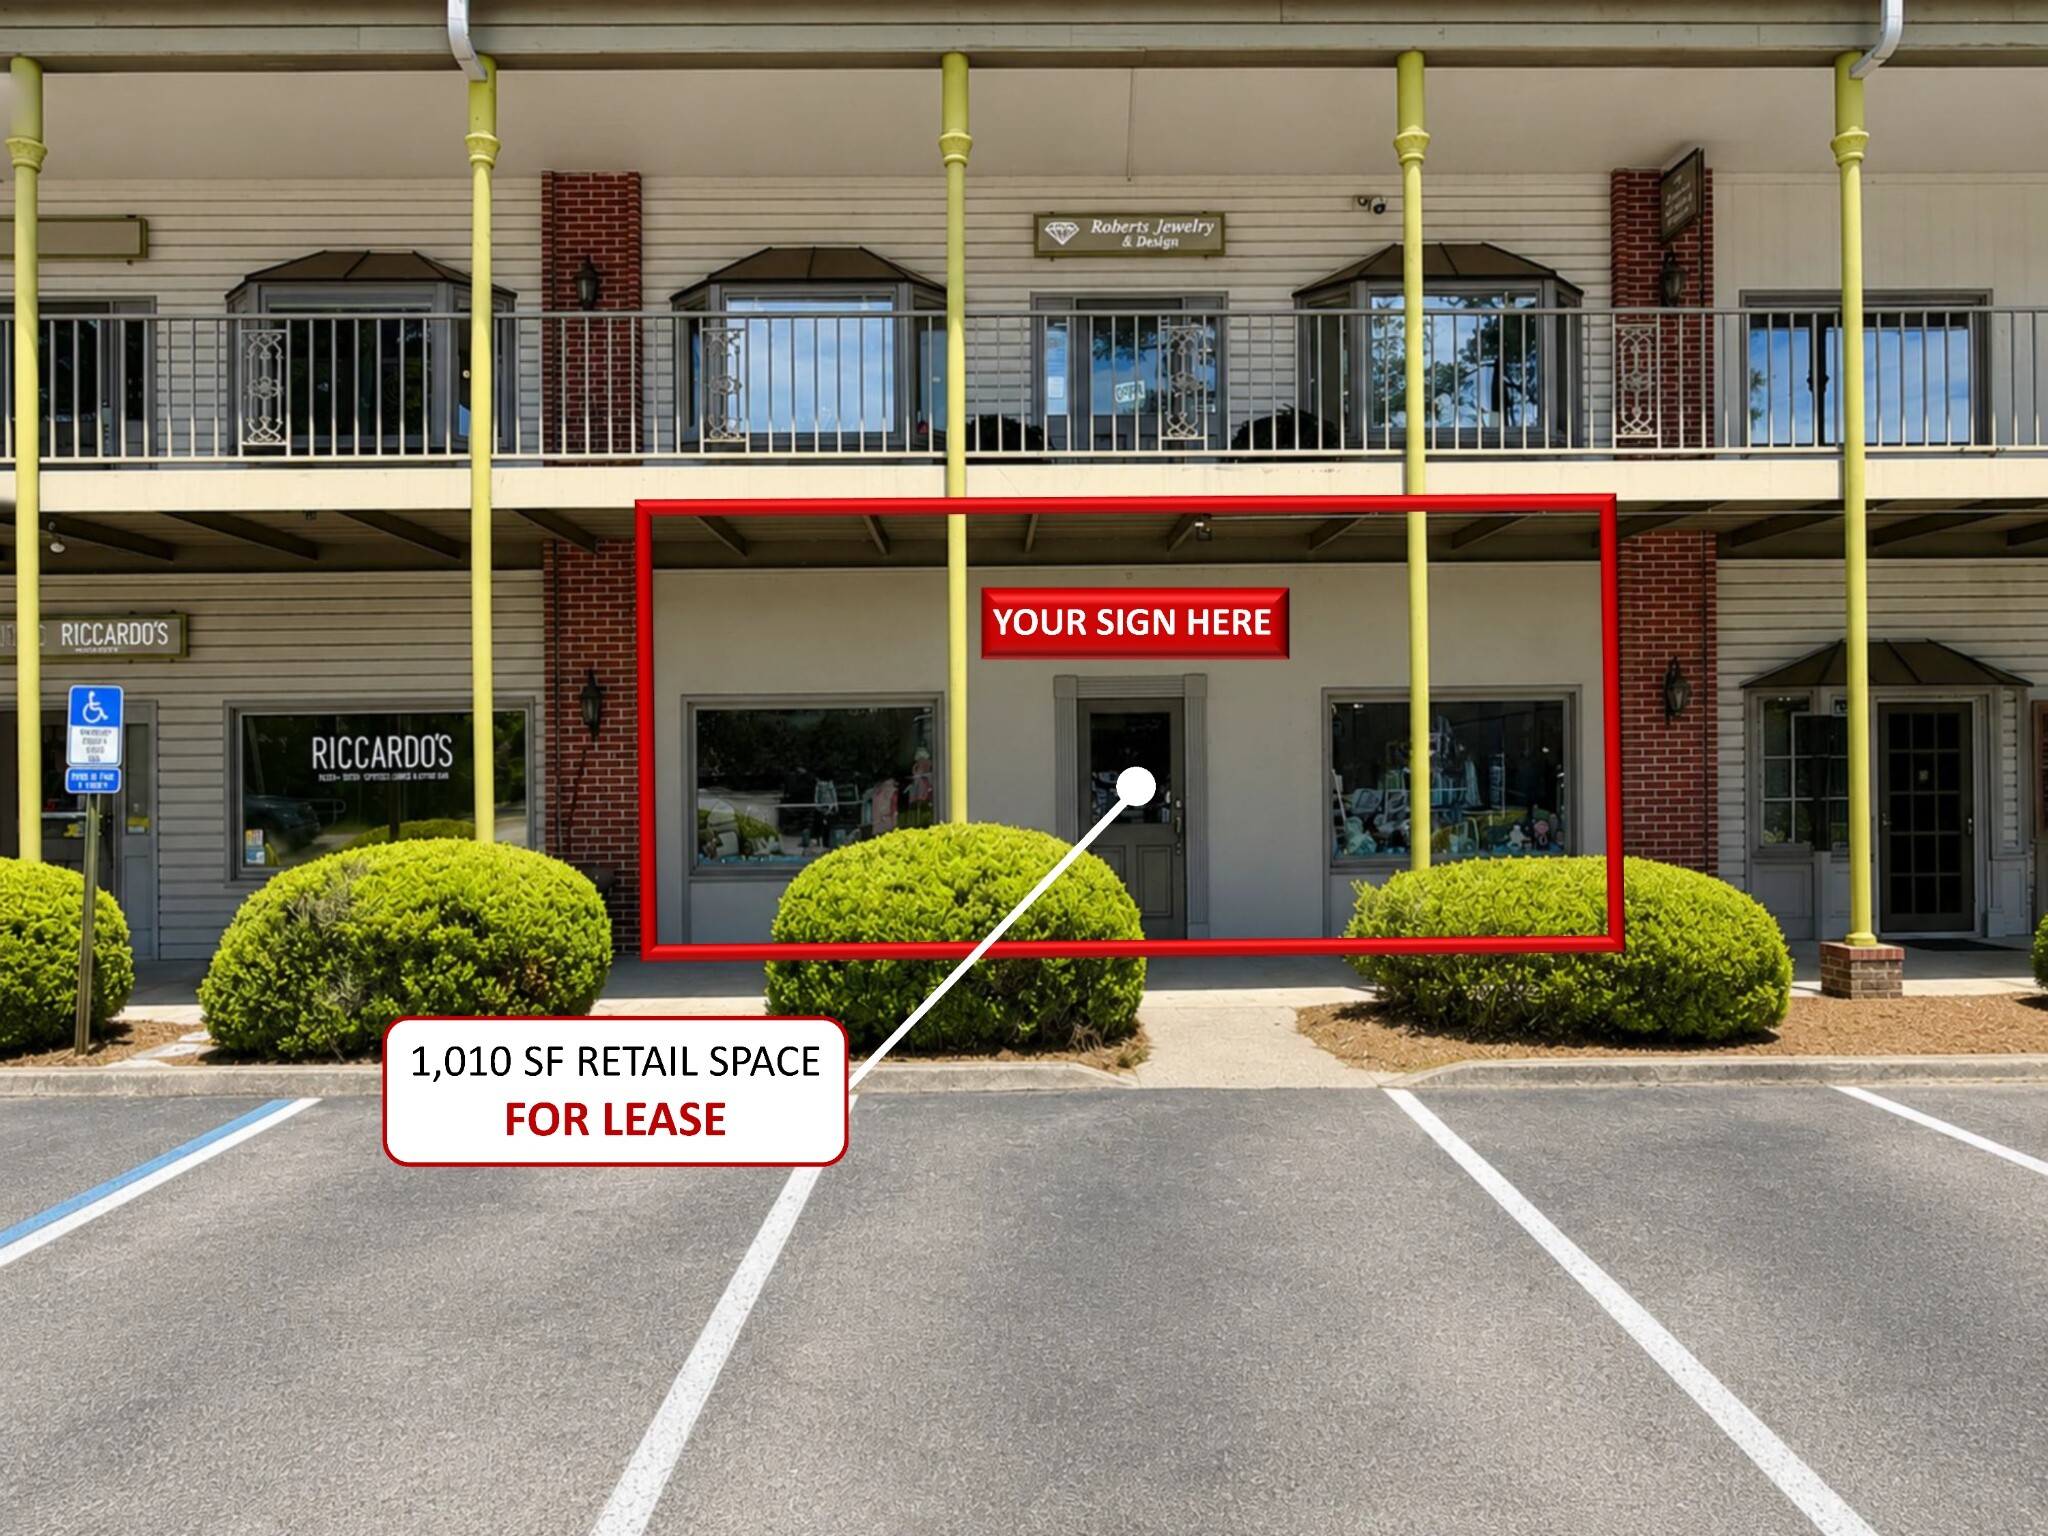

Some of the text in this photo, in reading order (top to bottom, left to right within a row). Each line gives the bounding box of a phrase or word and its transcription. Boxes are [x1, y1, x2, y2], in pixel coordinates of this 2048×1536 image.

[1091, 219, 1215, 236] Roberts Jewelry
[1122, 235, 1179, 250] & Design
[61, 621, 169, 647] RICCARDO'S
[312, 733, 453, 770] RICCARDO'S
